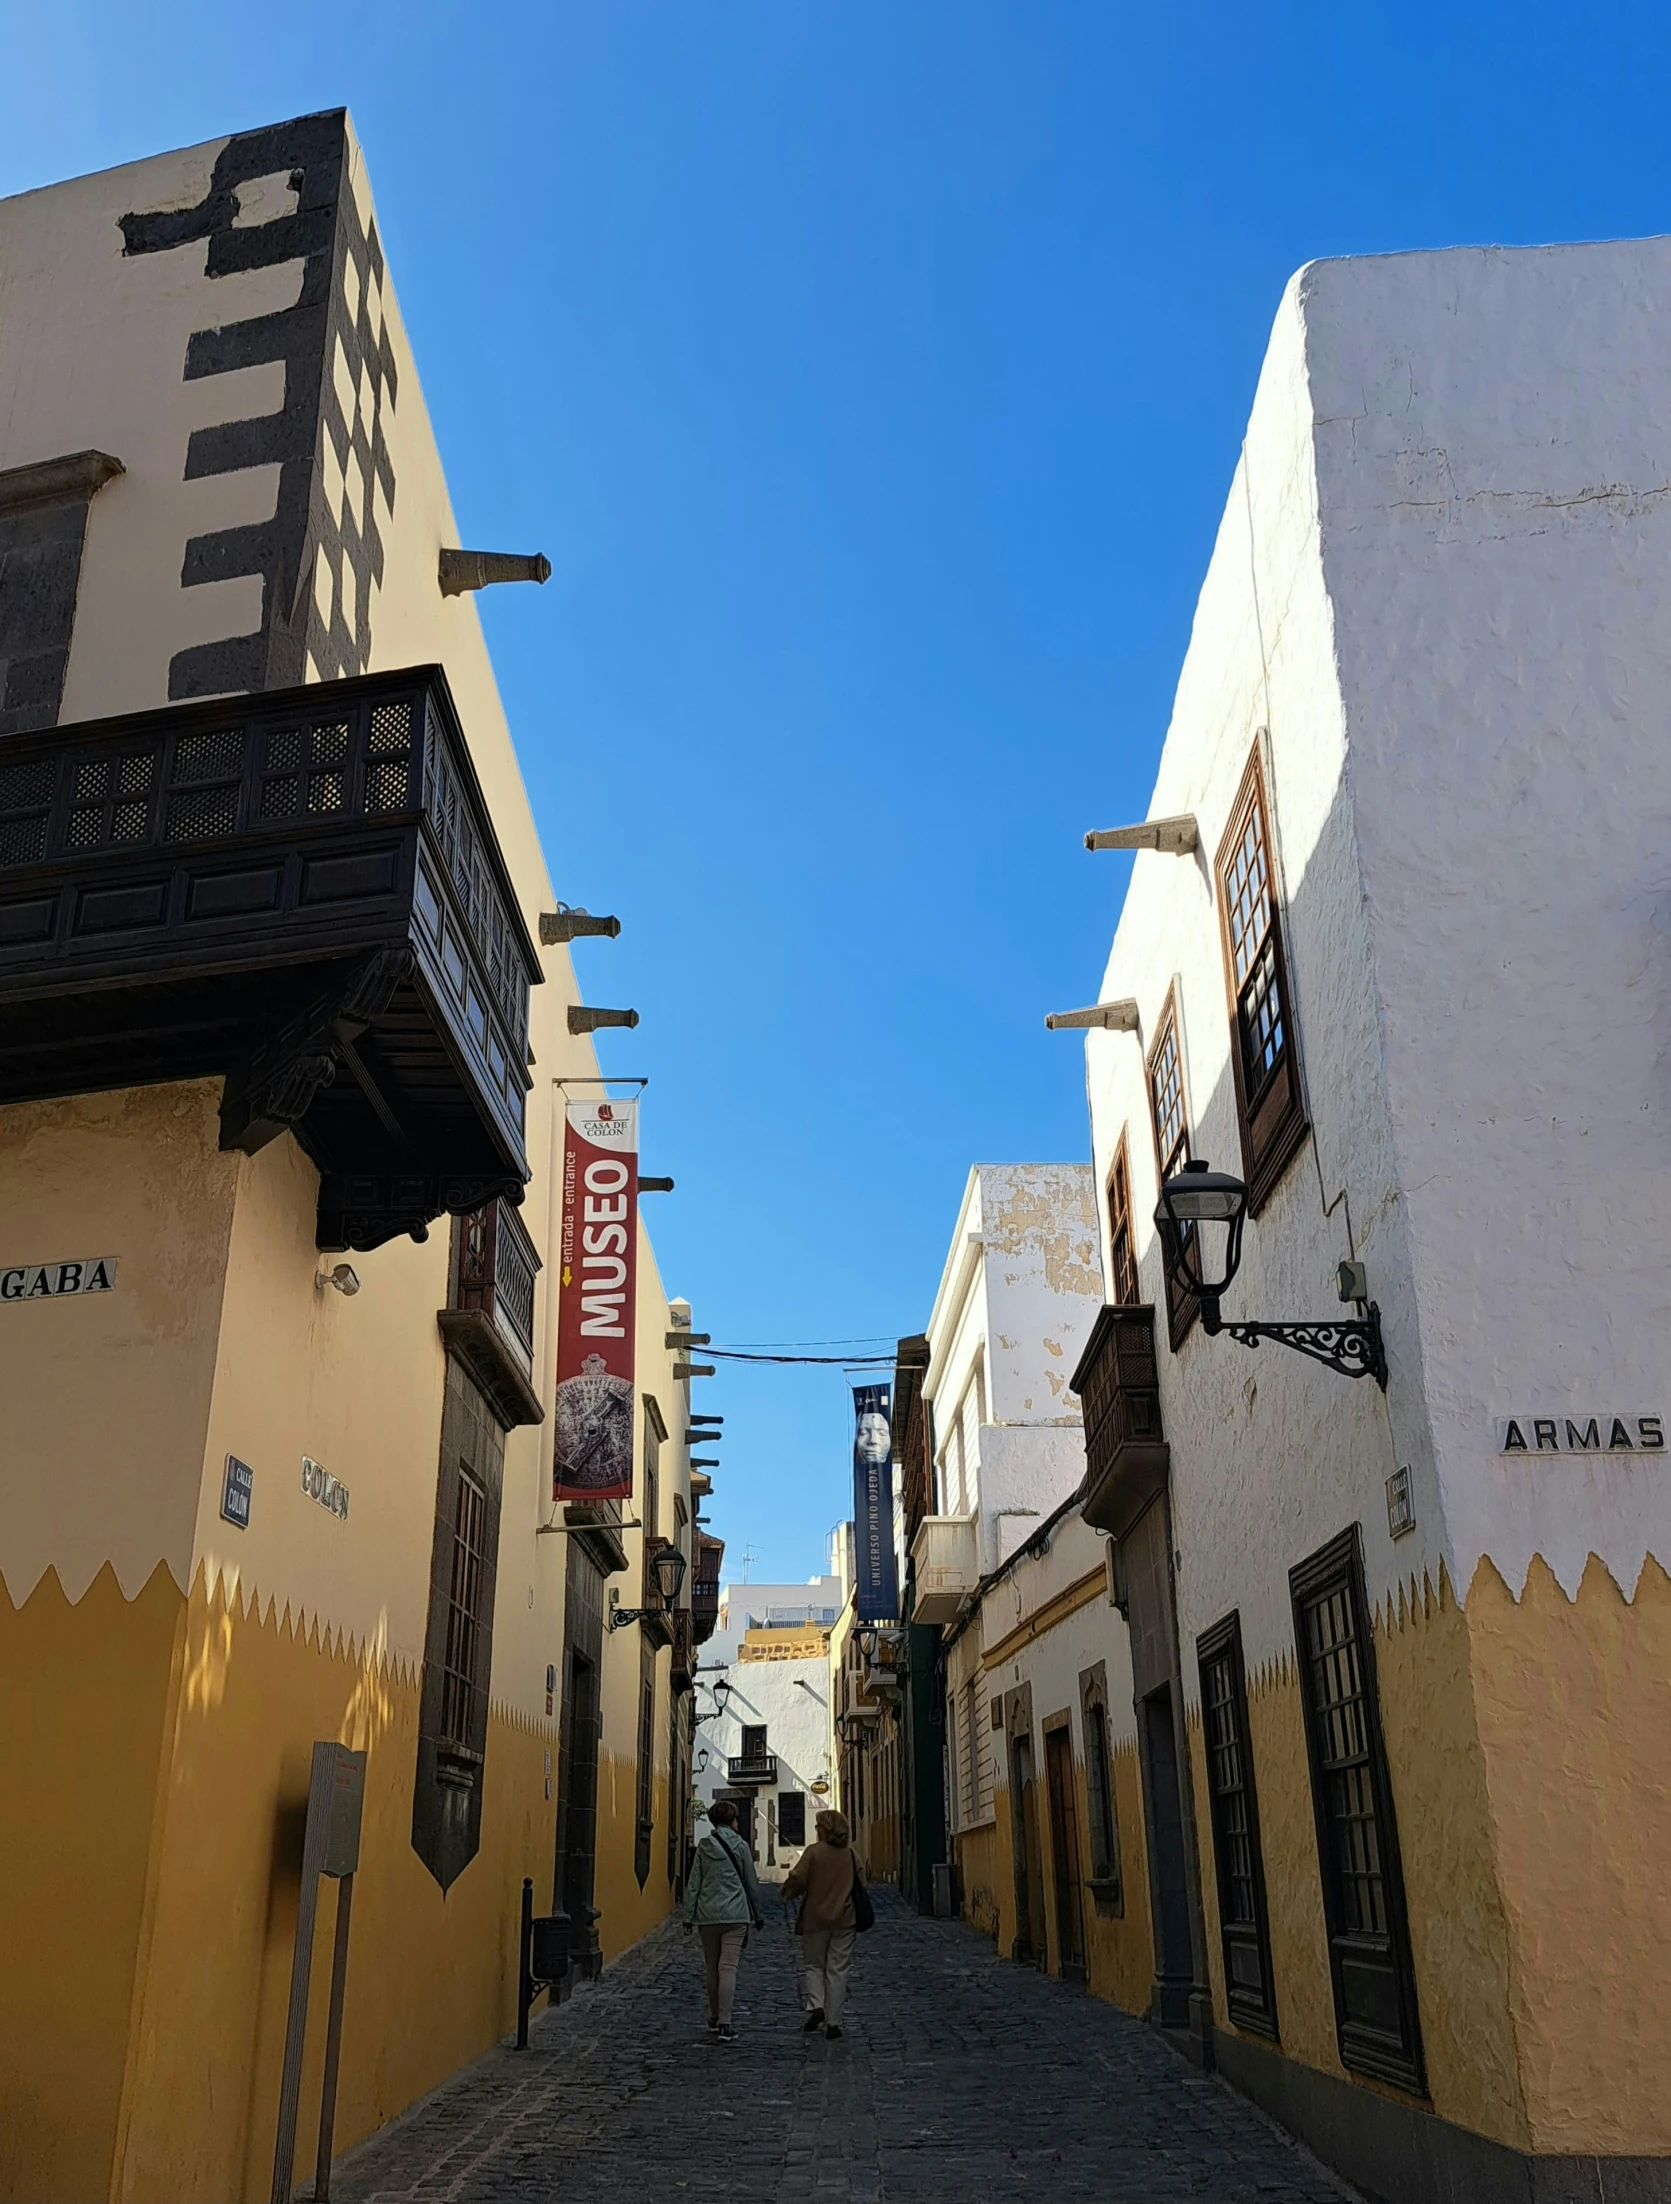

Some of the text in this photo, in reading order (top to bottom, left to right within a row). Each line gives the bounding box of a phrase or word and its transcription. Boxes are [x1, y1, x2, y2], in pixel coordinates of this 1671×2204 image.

[584, 1121, 628, 1130] CASA DE
[562, 1151, 576, 1264] entrada entrance
[580, 1159, 629, 1338] MUSEO
[1, 1260, 111, 1299] GABA
[1504, 1418, 1664, 1450] ARMAS
[236, 1467, 252, 1488] CALLE
[228, 1488, 248, 1518] COLÓN
[868, 1469, 882, 1586] UNIVERSO PINO OJEDA
